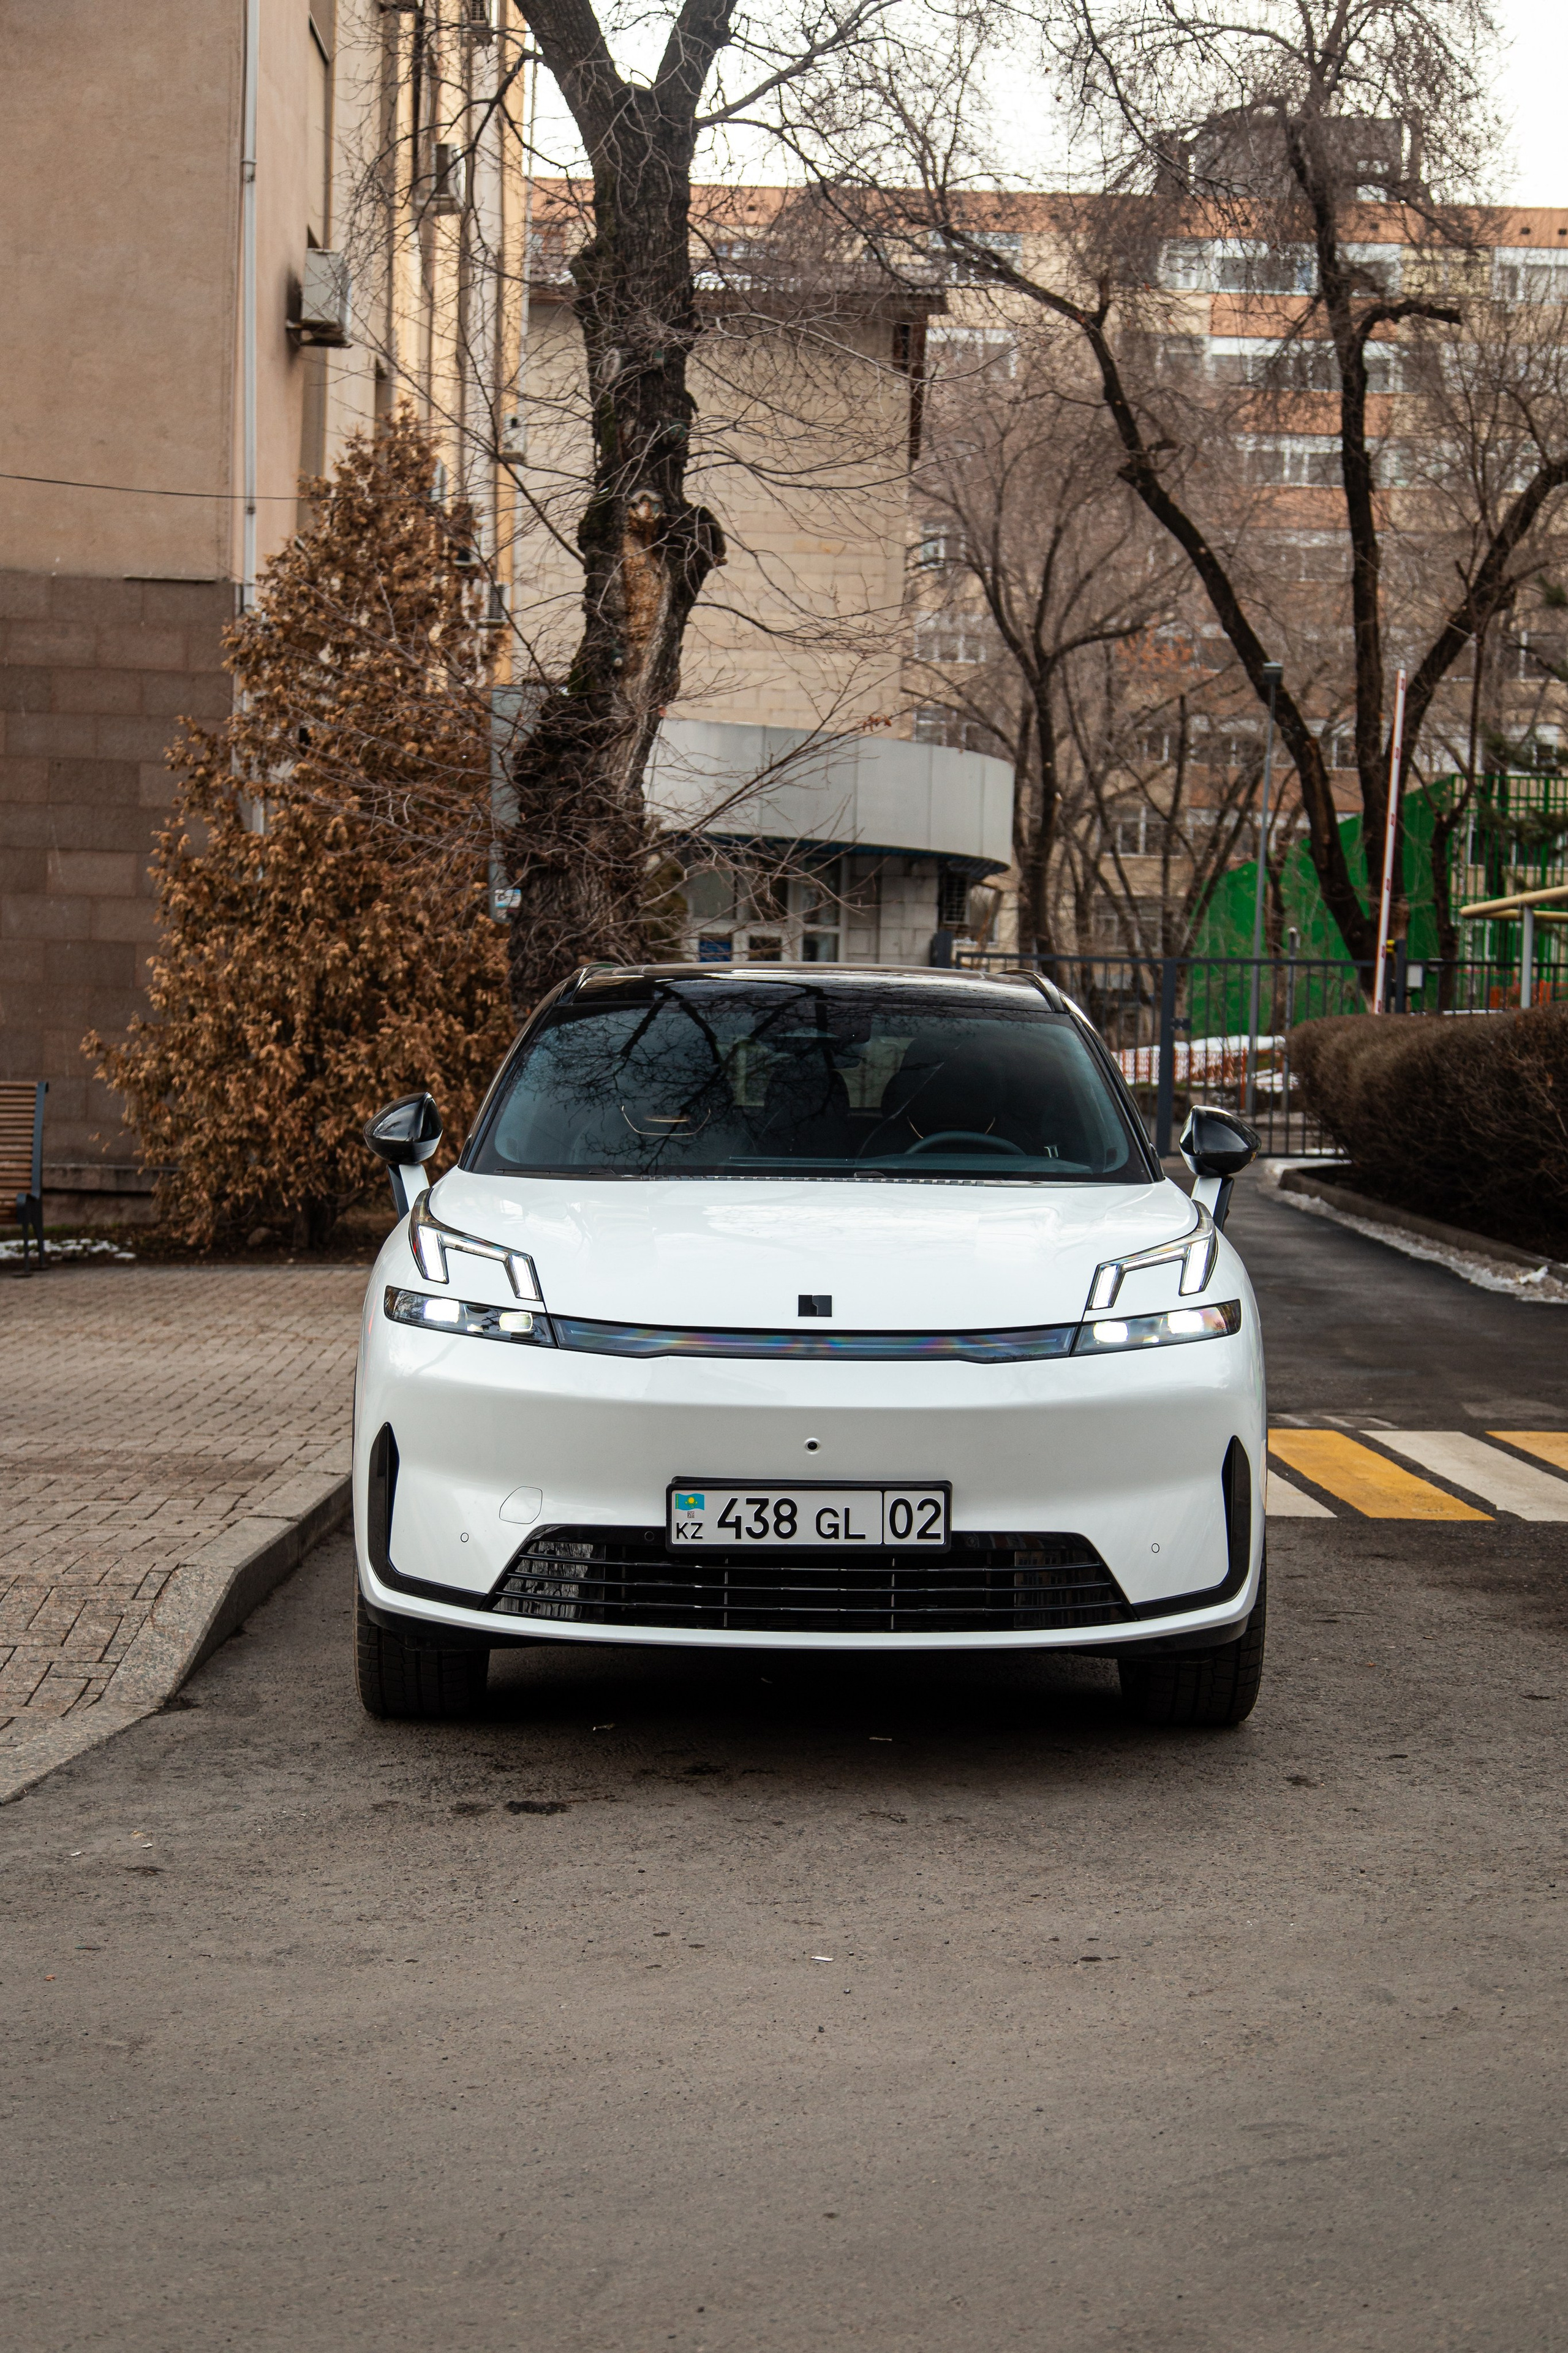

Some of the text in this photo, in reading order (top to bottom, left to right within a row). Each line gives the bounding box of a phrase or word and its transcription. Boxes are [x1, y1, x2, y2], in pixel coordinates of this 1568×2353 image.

[676, 1522, 703, 1539] KZ
[717, 1497, 941, 1539] 438 GL 02
